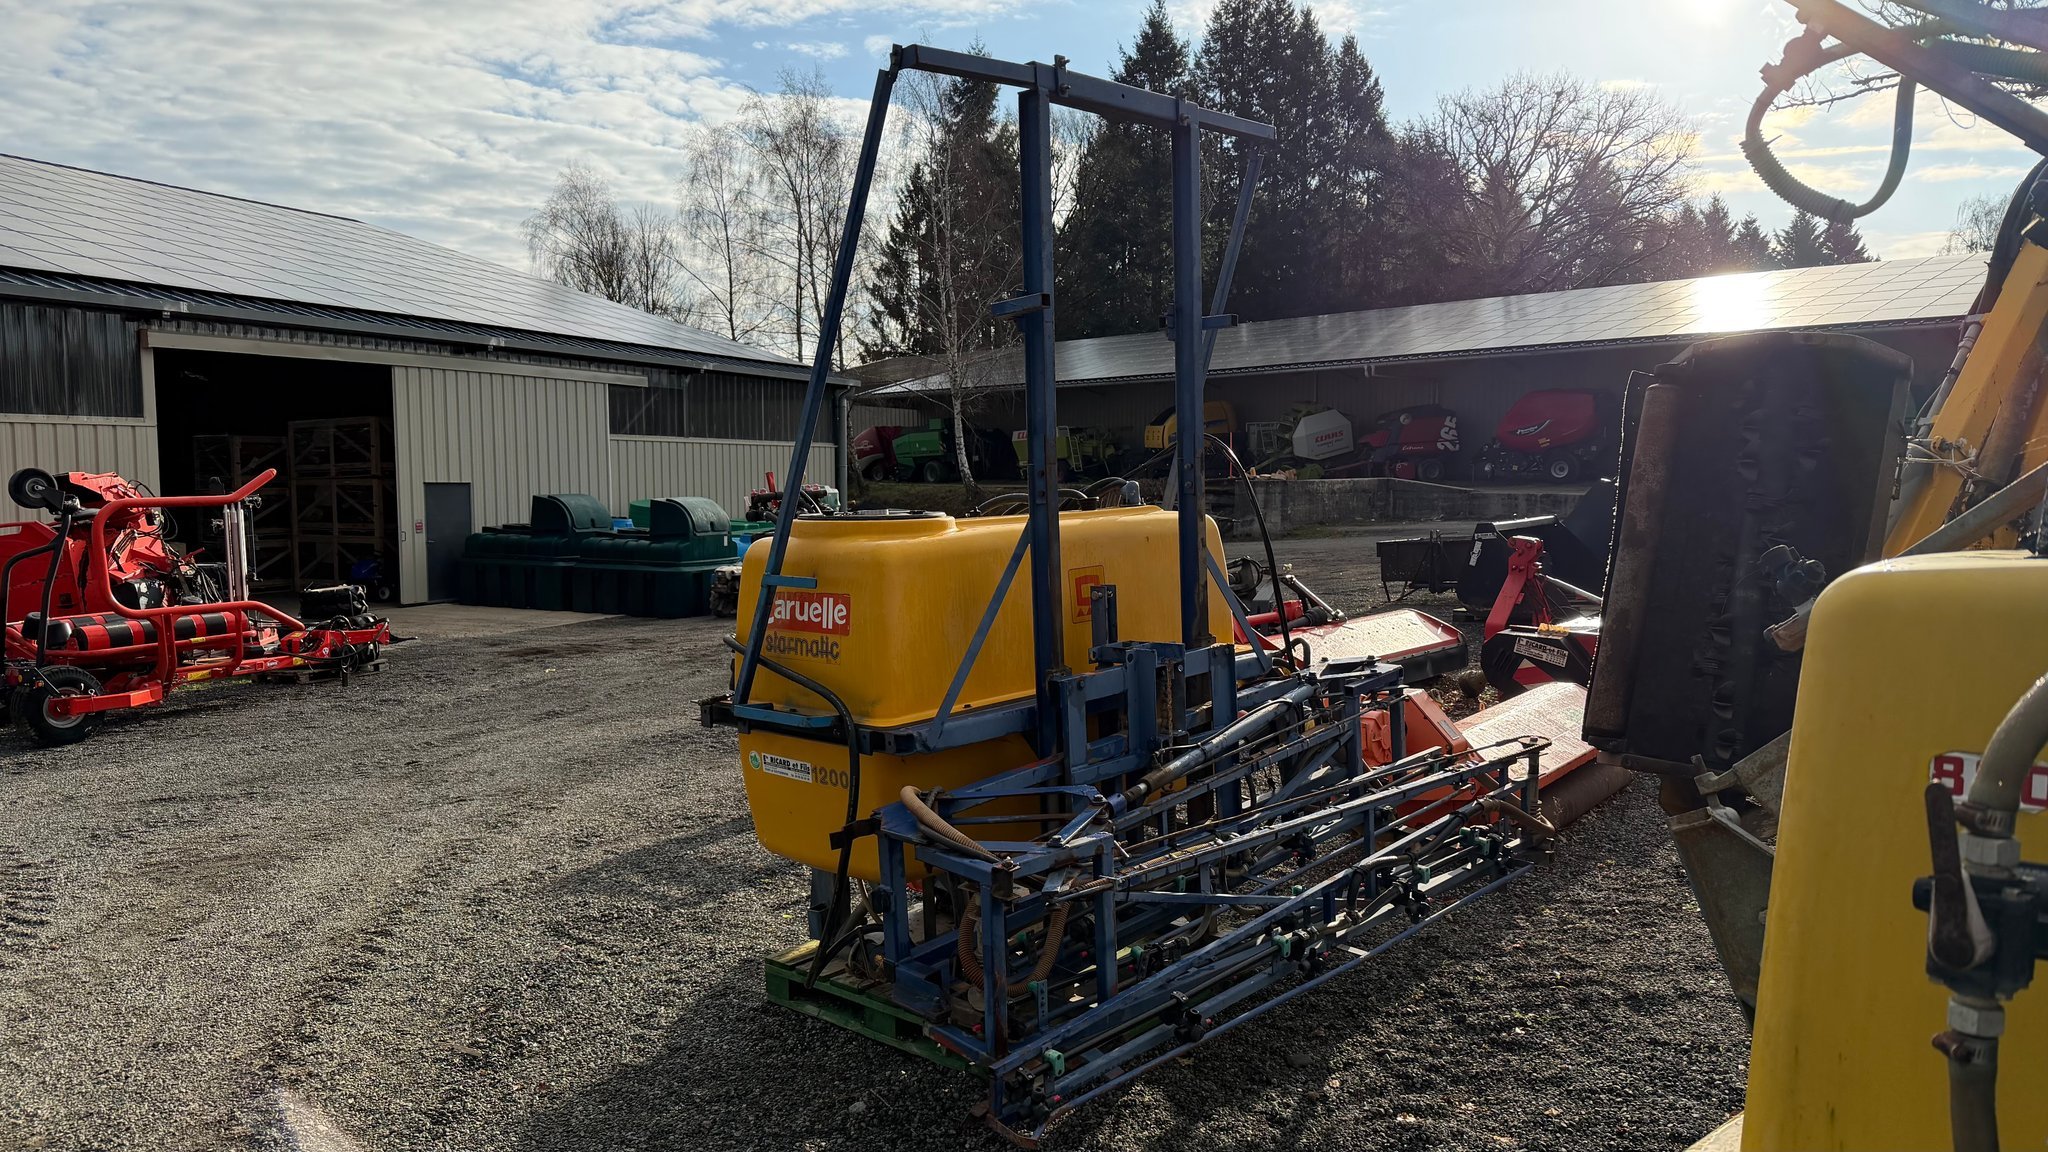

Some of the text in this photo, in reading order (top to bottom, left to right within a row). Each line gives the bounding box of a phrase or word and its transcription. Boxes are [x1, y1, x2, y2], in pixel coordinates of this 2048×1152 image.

[767, 597, 847, 629] aruelle
[766, 631, 840, 661] starmatic
[770, 756, 791, 767] RICARD
